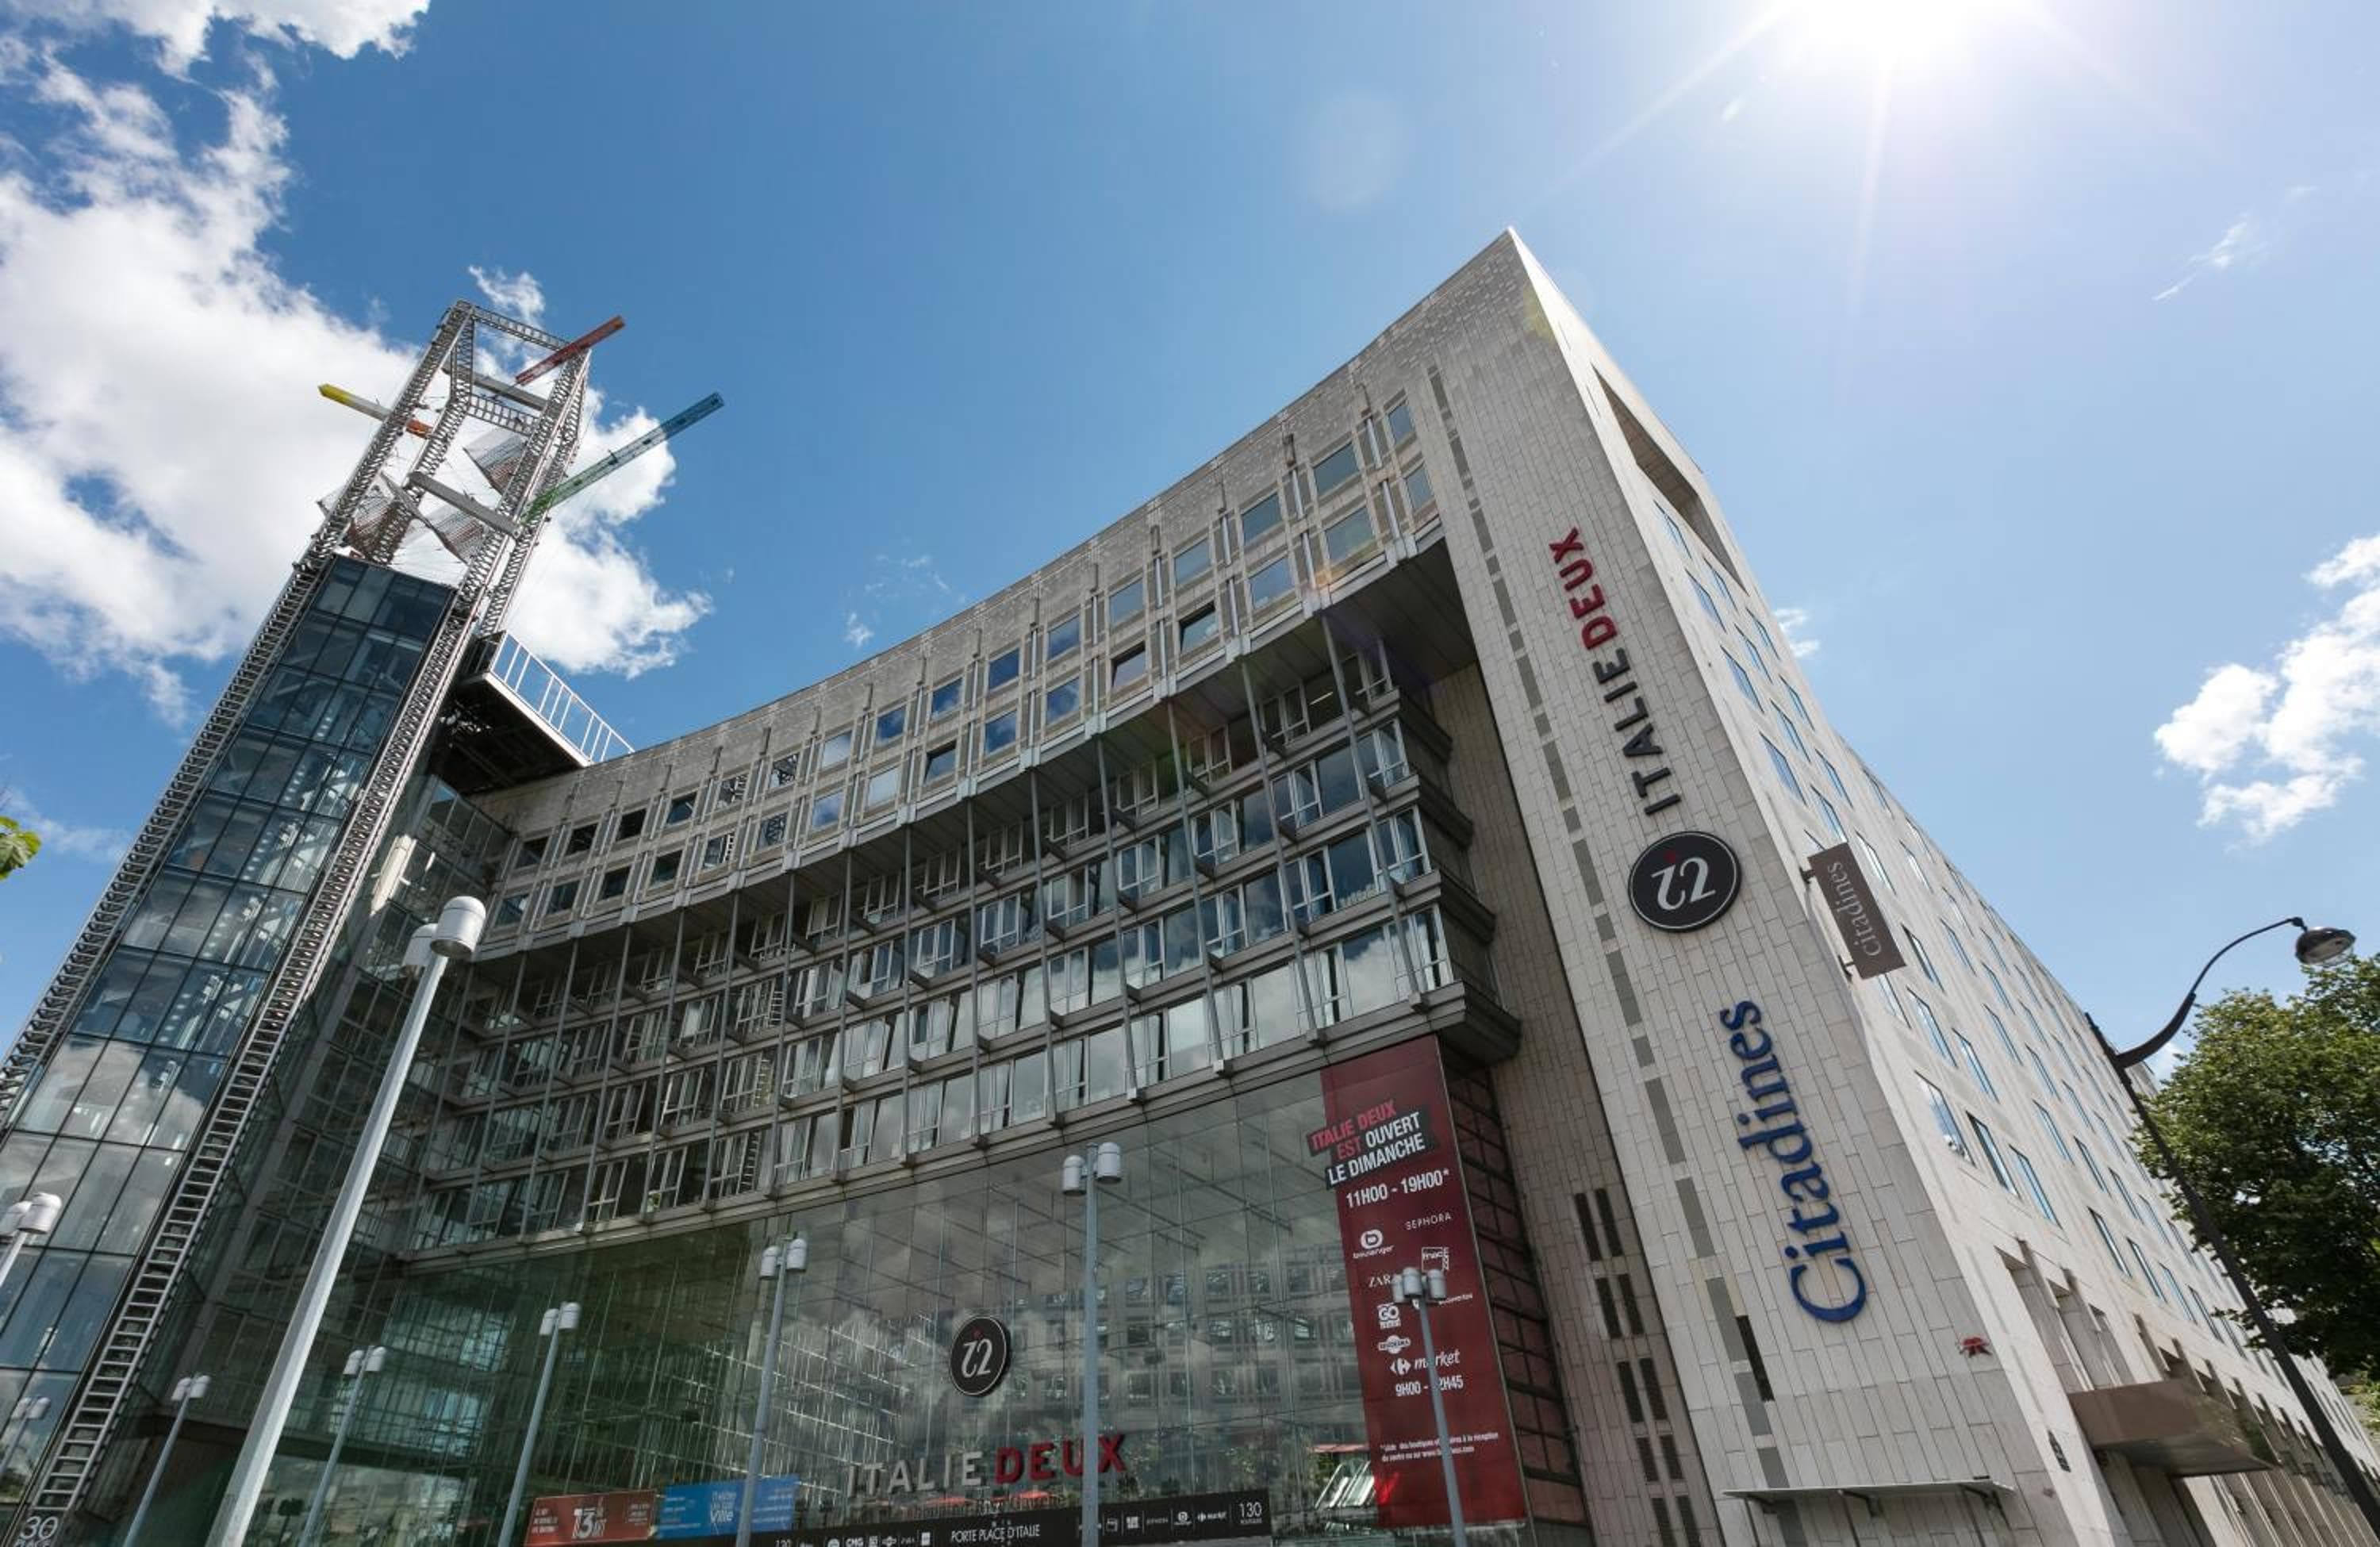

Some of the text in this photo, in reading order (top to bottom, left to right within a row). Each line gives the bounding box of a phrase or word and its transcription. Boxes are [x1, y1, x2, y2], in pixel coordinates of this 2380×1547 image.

[1549, 526, 1683, 817] ITALIE DEUX
[1311, 1099, 1397, 1150] ITALIE DEUX
[1338, 1111, 1421, 1160] EST OUVERT
[1327, 1132, 1426, 1185] LE DIMANCHE
[1720, 999, 1868, 1324] Citadines
[1346, 1183, 1388, 1208] 11H00
[1405, 1211, 1452, 1230] SEPHORA
[1368, 1274, 1392, 1288] ZAR
[1415, 1349, 1461, 1369] mrket
[846, 1432, 1128, 1499] ITALIE DEUX
[1238, 1501, 1263, 1518] 130
[20, 1515, 59, 1539] 30
[951, 1523, 1042, 1543] PORTE PLACE D'ITALIE
